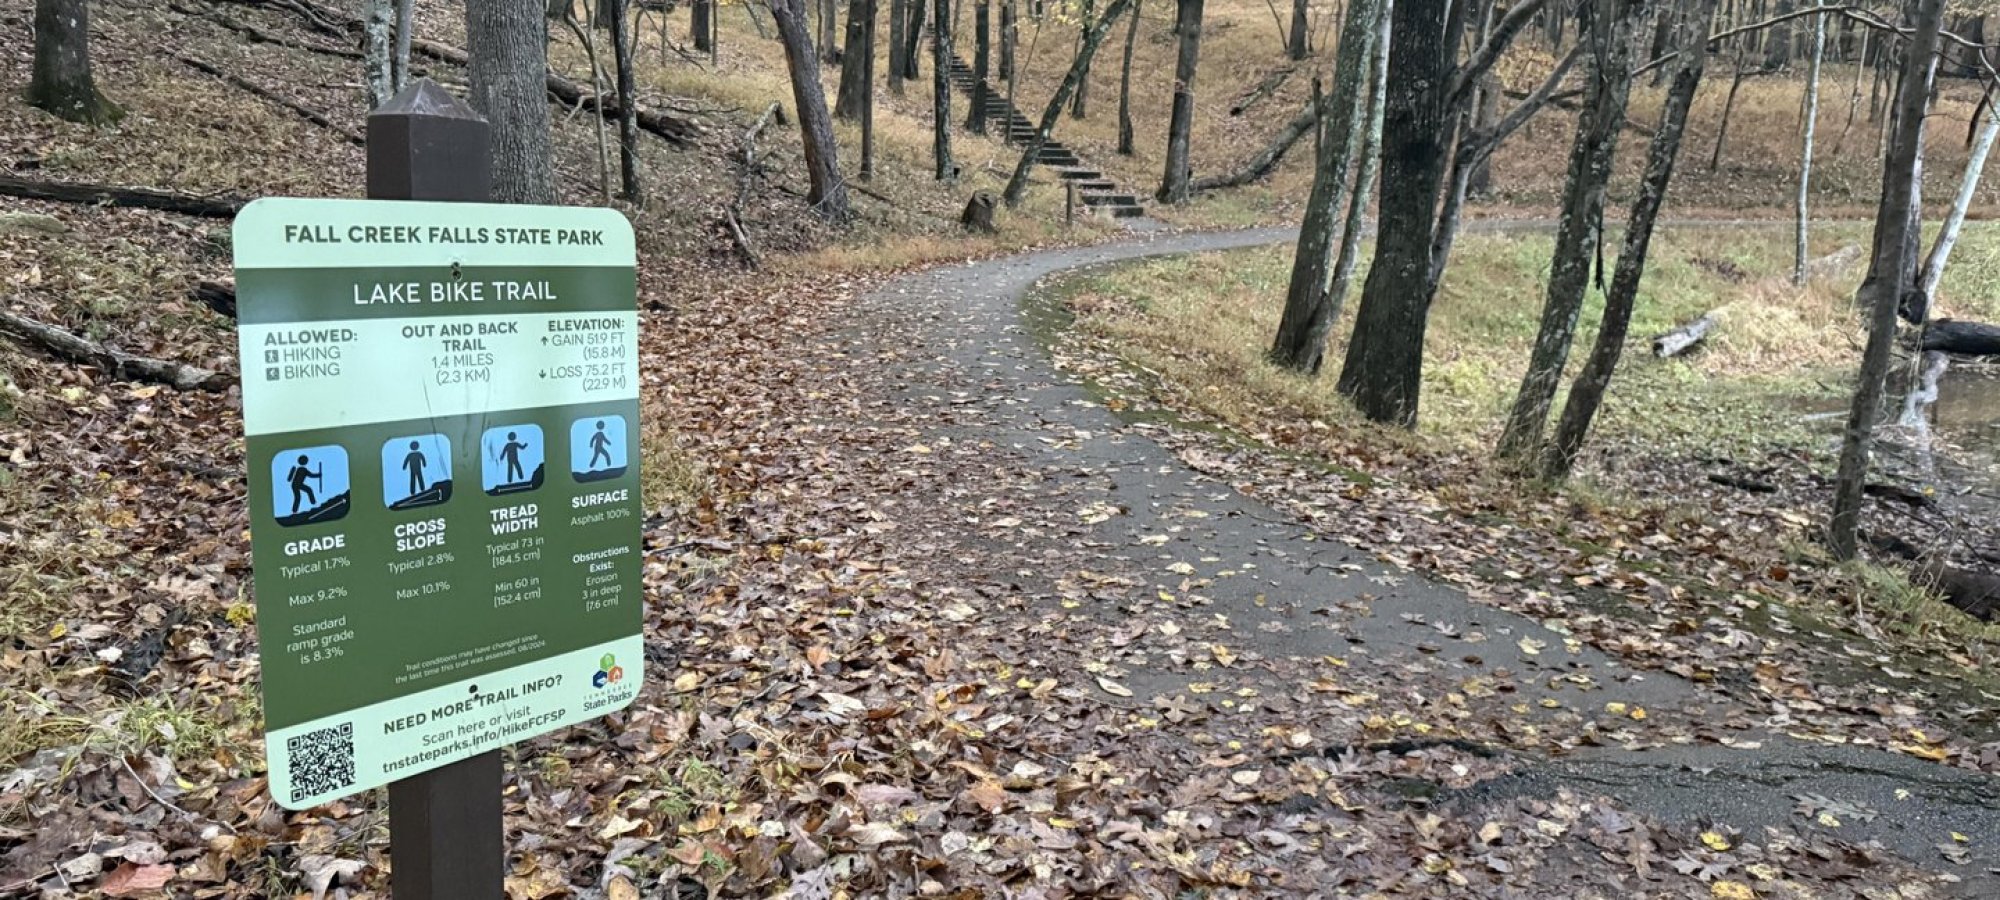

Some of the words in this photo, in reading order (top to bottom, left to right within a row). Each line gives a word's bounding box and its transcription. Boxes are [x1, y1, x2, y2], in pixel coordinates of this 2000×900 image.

[285, 225, 340, 243] FALL
[348, 227, 421, 243] CREEK
[429, 227, 489, 243] FALLS
[495, 228, 550, 244] STATE
[558, 230, 603, 245] PARK
[354, 283, 420, 304] LAKE
[431, 282, 484, 302] BIKE
[492, 281, 556, 301] TRAIL
[402, 325, 435, 338] OUT
[440, 323, 473, 336] AND
[478, 322, 518, 335] BACK
[548, 318, 625, 332] ELEVATION:
[265, 329, 357, 346] ALLOWED:
[443, 339, 486, 352] TRAIL
[552, 334, 584, 346] GAIN
[612, 332, 624, 344] FT
[283, 347, 340, 361] HIKING
[611, 345, 625, 358] M)
[432, 356, 449, 368] 1.4
[453, 353, 493, 367] MILES
[285, 363, 340, 378] BIKING
[436, 370, 461, 384] (2.3
[465, 368, 490, 383] KM)
[550, 366, 582, 378] LOSS
[585, 364, 608, 376] 75.2
[612, 363, 625, 375] FT
[613, 376, 626, 390] M)
[572, 489, 628, 508] SURFACE
[490, 504, 538, 521] TREAD
[571, 512, 604, 526] Asphalt
[607, 508, 630, 519] 100%
[394, 518, 446, 537] CROSS
[491, 517, 538, 535] WIDTH
[285, 534, 345, 555] GRADE
[397, 533, 444, 551] SLOPE
[486, 540, 518, 555] Typical
[522, 537, 533, 547] 73
[536, 536, 543, 544] in
[523, 548, 540, 560] cm]
[573, 546, 630, 563] Obstructions
[280, 561, 321, 579] Typical
[388, 558, 424, 574] Typical
[428, 552, 454, 566] 2.8%
[590, 561, 614, 573] Exist:
[496, 584, 512, 593] Min
[515, 578, 528, 588] 60
[531, 577, 539, 585] in
[586, 571, 618, 586] Erosion
[289, 595, 314, 607] Max
[318, 586, 347, 600] 9.2%
[397, 588, 419, 600] Max
[524, 587, 541, 600] cm]
[582, 590, 588, 599] 3
[590, 589, 598, 597] in
[600, 583, 621, 597] deep
[603, 596, 618, 607] cm]
[293, 615, 346, 635] Standard
[287, 638, 318, 652] ramp
[322, 630, 354, 648] grade
[301, 653, 310, 664] is
[314, 647, 343, 661] 8.3%
[406, 663, 420, 671] Trail
[422, 654, 457, 668] conditions
[475, 646, 490, 654] have
[492, 638, 519, 651] changed
[522, 634, 538, 642] since
[396, 675, 407, 683] the
[410, 672, 422, 680] last
[424, 668, 439, 676] time
[442, 664, 454, 672] this
[456, 660, 468, 668] trail
[384, 713, 426, 734] NEED
[432, 702, 473, 721] MORE
[479, 687, 518, 707] TRAIL
[523, 674, 562, 694] INFO?
[584, 699, 606, 711] State
[608, 692, 632, 704] Parks
[422, 729, 453, 746] Scan
[458, 719, 485, 737] here
[489, 717, 502, 727] or
[507, 706, 530, 722] visit
[383, 709, 566, 773] tnstateparks.info/HikeFCFSP
